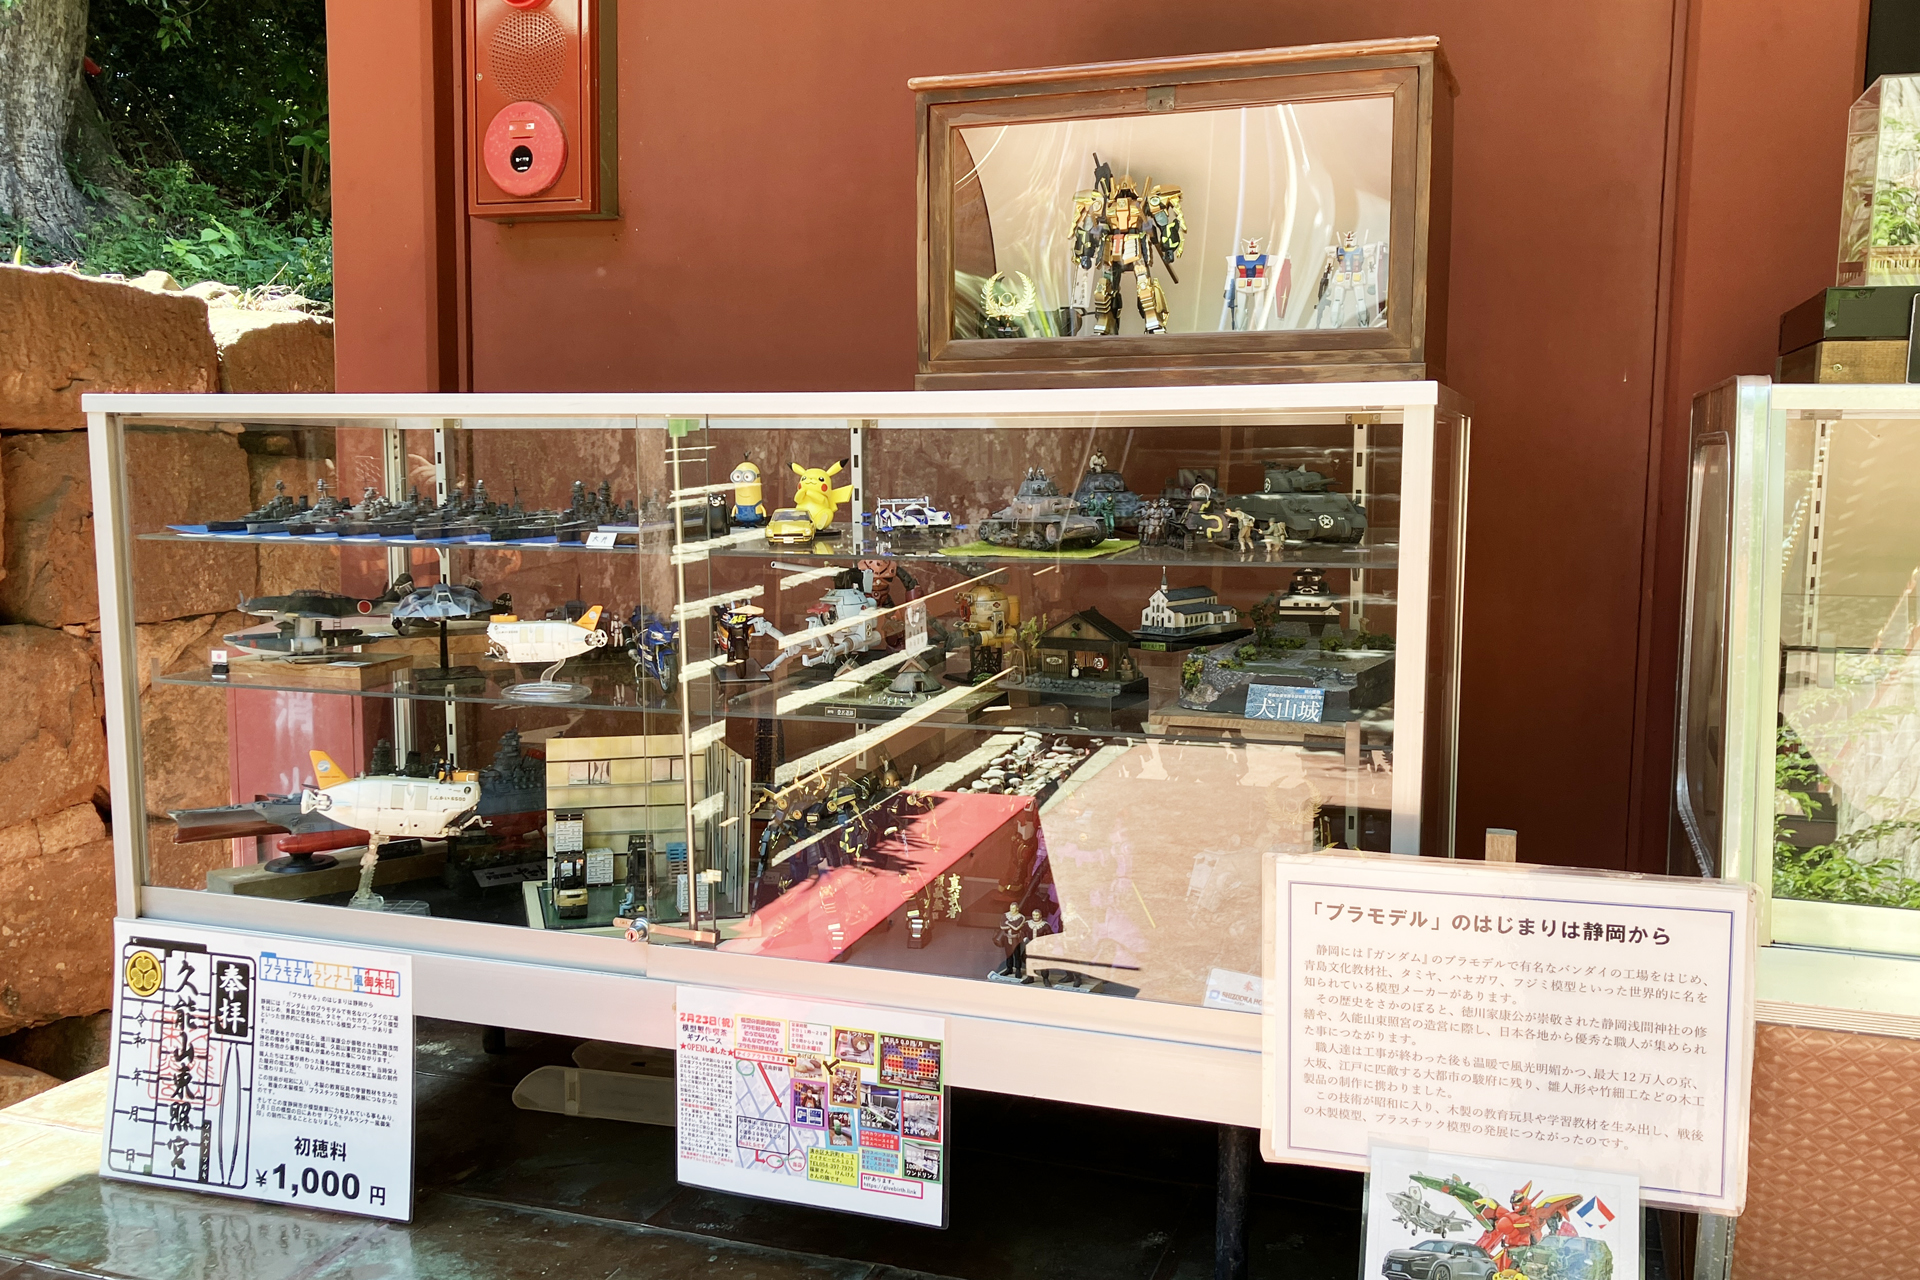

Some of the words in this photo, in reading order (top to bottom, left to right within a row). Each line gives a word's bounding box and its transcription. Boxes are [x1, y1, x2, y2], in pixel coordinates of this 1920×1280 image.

[729, 614, 747, 624] 46
[1253, 697, 1321, 722] 犬山城
[1314, 900, 1671, 948] 「プラモデル」のはじまりは静岡から
[263, 962, 394, 990] プラモデルランナー風御朱印
[1316, 943, 1709, 988] 静岡には『ガンダム』のプラモデルで有名なバンダイの工場をはじめ、
[1304, 958, 1708, 1004] 青島文化教材社、タミヤ、ハセガワ、フジミ模型といった世界的に名を
[1304, 975, 1518, 1005] 知られている模型メーカーがあります。
[218, 963, 248, 1035] 奉拝
[1304, 1024, 1417, 1046] た事につながります。
[167, 959, 200, 1171] 久能山東照宮
[1303, 1072, 1454, 1099] 製品の制作に携わりました。
[128, 1105, 138, 1122] 月
[1303, 1104, 1630, 1151] の木製模型、プラスチック模型の発展につながったのです。
[1316, 1089, 1703, 1142] この技術が昭和に入り、木製の教育玩具や学習教材を生み出し、戦後
[125, 1147, 135, 1163] 日
[294, 1135, 347, 1162] 初穂料
[369, 1184, 386, 1206] 円
